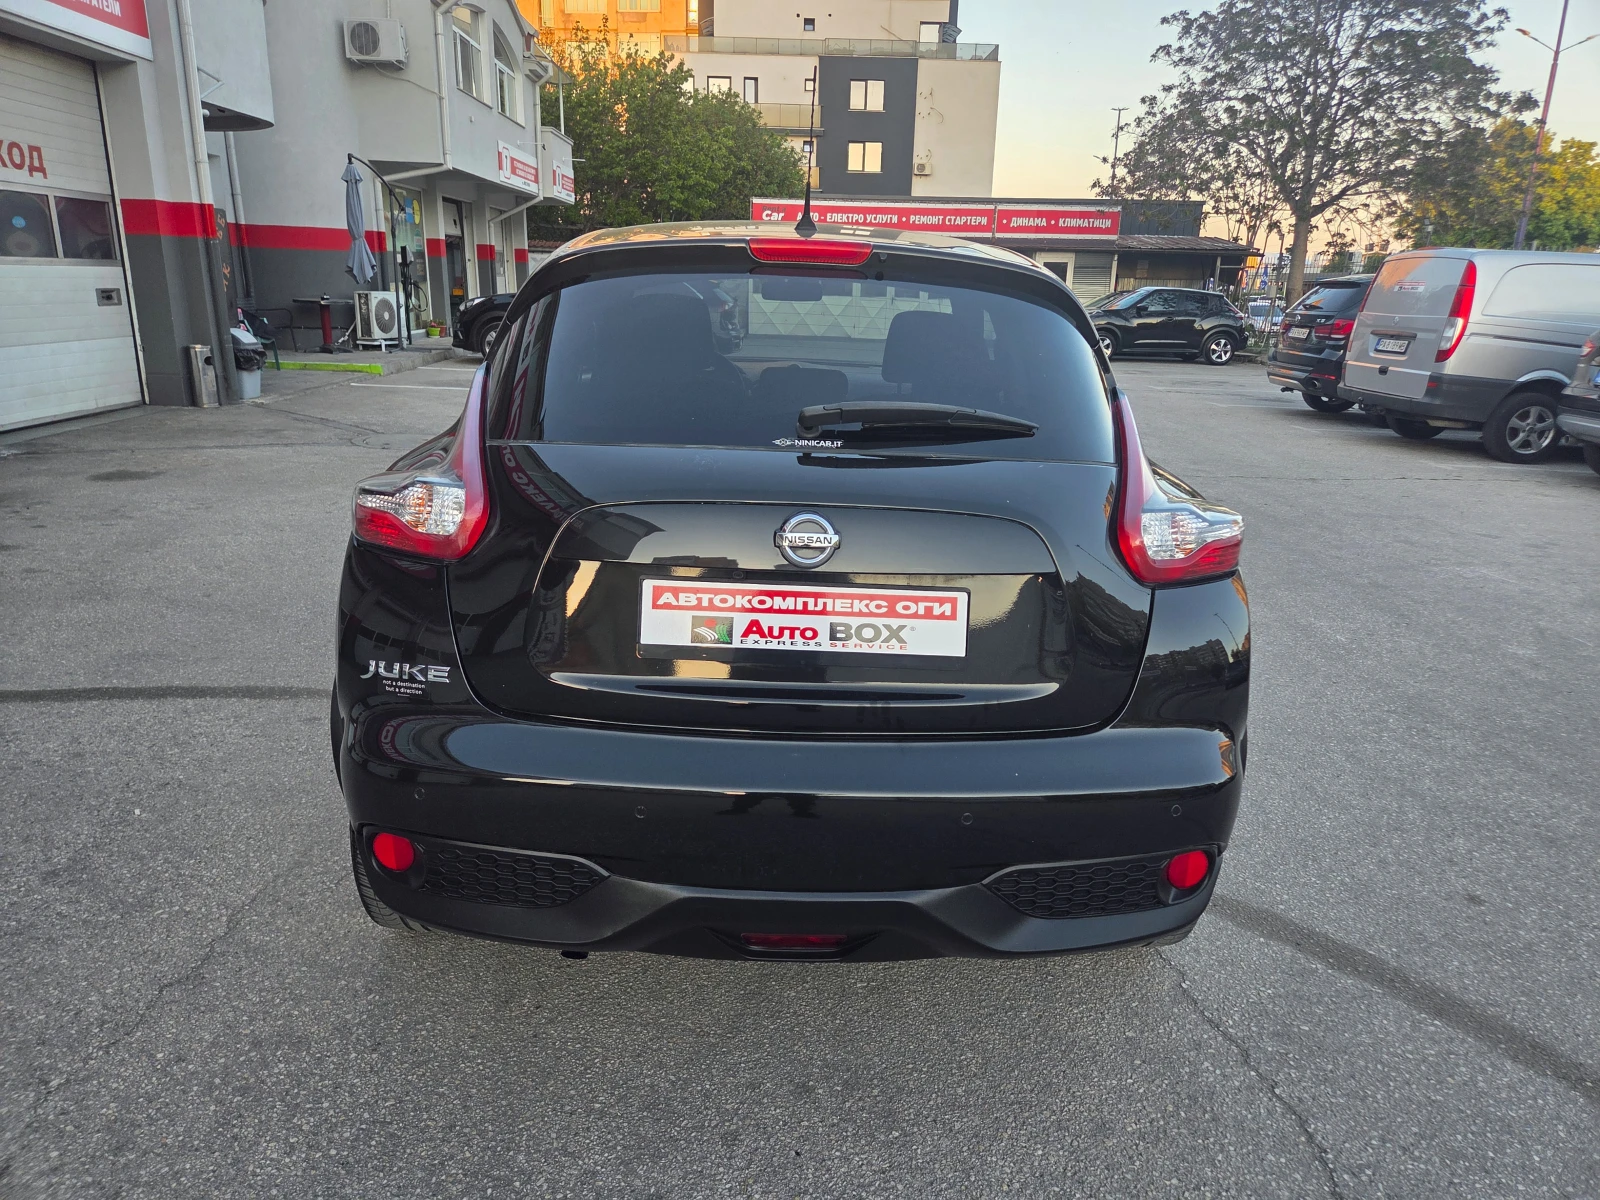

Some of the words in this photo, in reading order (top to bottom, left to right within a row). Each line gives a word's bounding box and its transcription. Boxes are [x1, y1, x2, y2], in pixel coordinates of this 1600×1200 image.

[762, 211, 784, 221] Car
[796, 213, 819, 222] АТО
[826, 213, 864, 223] ЕЛЕКТРО
[866, 213, 898, 224] УСЛУГИ
[909, 215, 943, 225] РЕМОНТ
[945, 216, 988, 226] СТАРТЕРИ
[1009, 217, 1047, 228] ДИНАМА
[1058, 218, 1112, 229] КЛИМАТИЦИ
[794, 439, 842, 448] NINICAR.IT
[783, 535, 833, 546] NISSAN
[656, 591, 889, 614] АВТОКОМПЛЕКС
[895, 600, 952, 616] ОГИ
[829, 622, 908, 644] BOX
[740, 639, 822, 648] EXPRESS
[829, 642, 908, 651] SERVICE
[360, 660, 451, 683] JUKE
